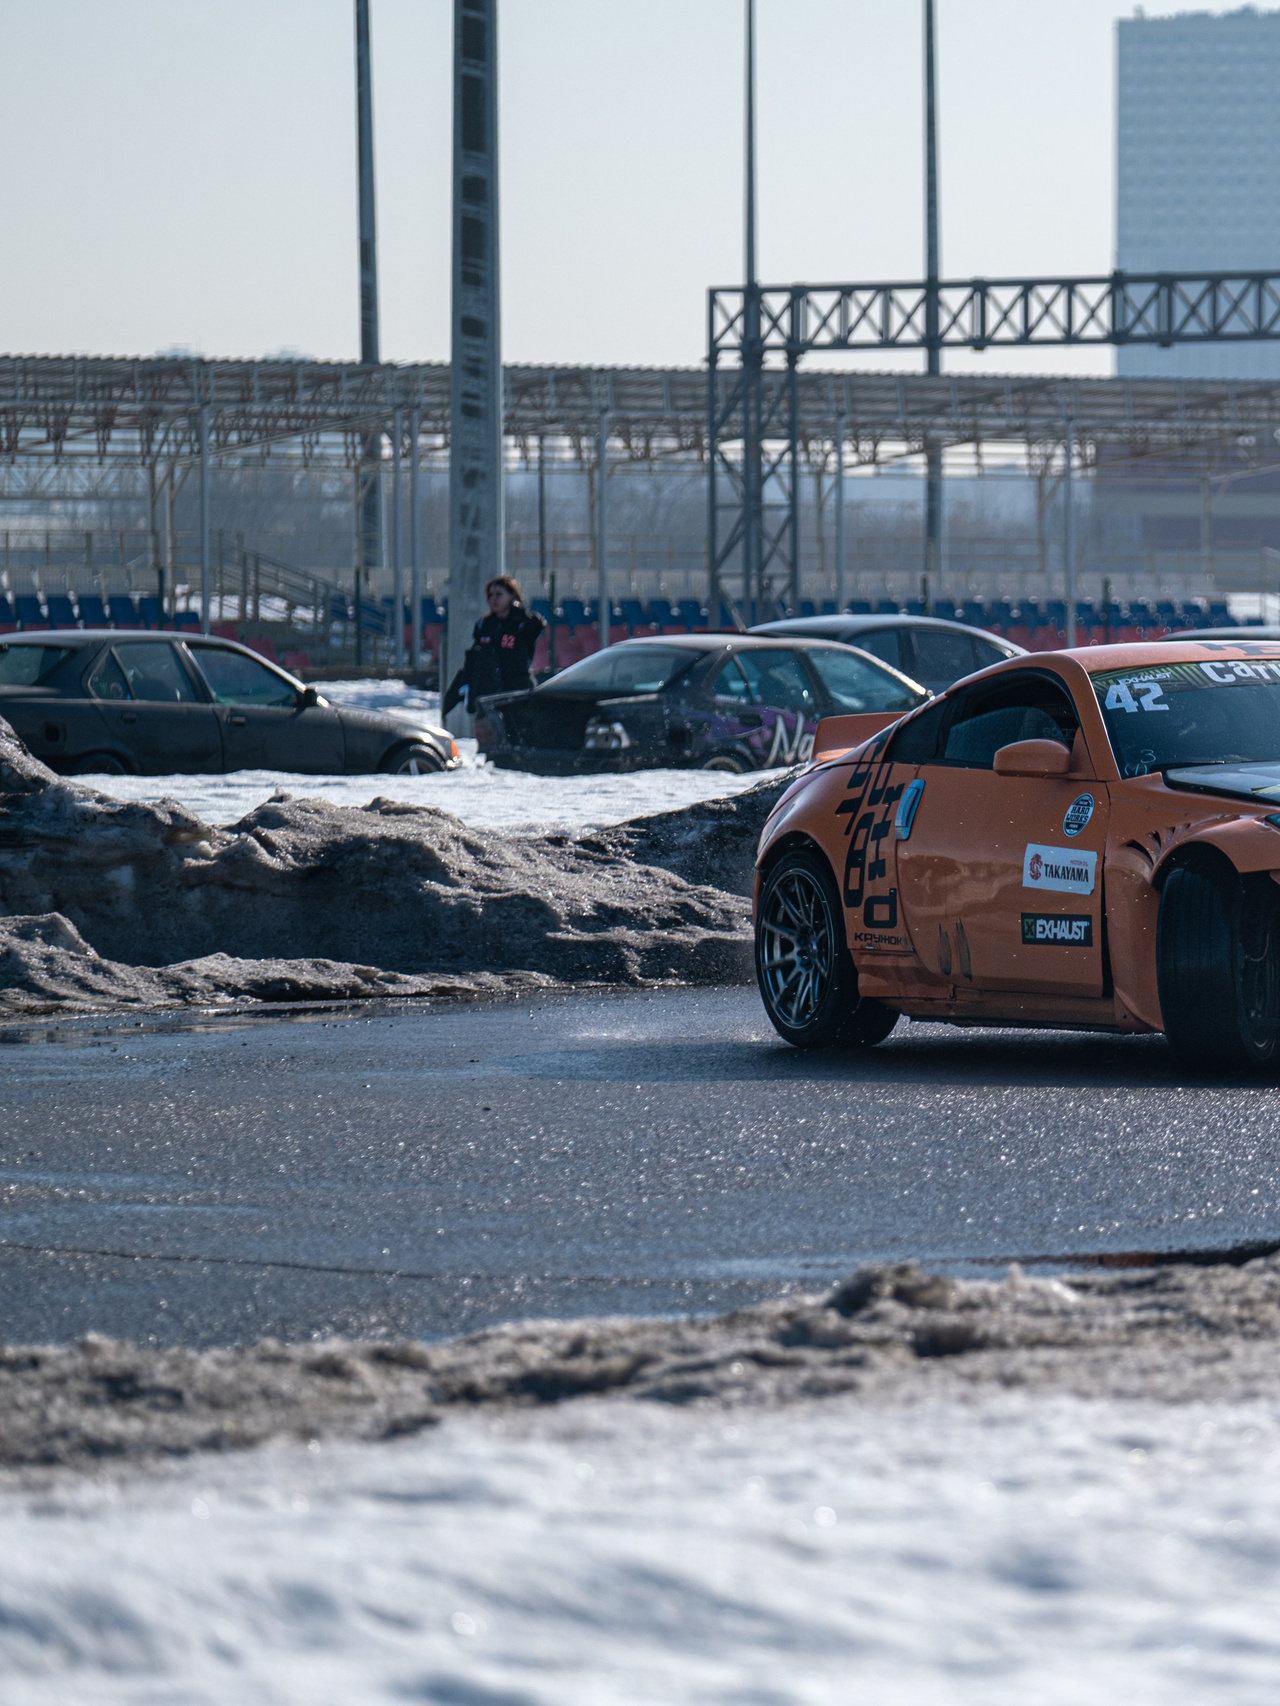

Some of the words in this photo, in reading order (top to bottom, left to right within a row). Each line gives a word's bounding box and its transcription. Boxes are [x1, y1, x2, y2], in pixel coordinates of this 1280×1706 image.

[1105, 680, 1170, 713] 42
[1044, 864, 1089, 883] TAKAYAMA
[1036, 919, 1088, 940] EXHAUST
